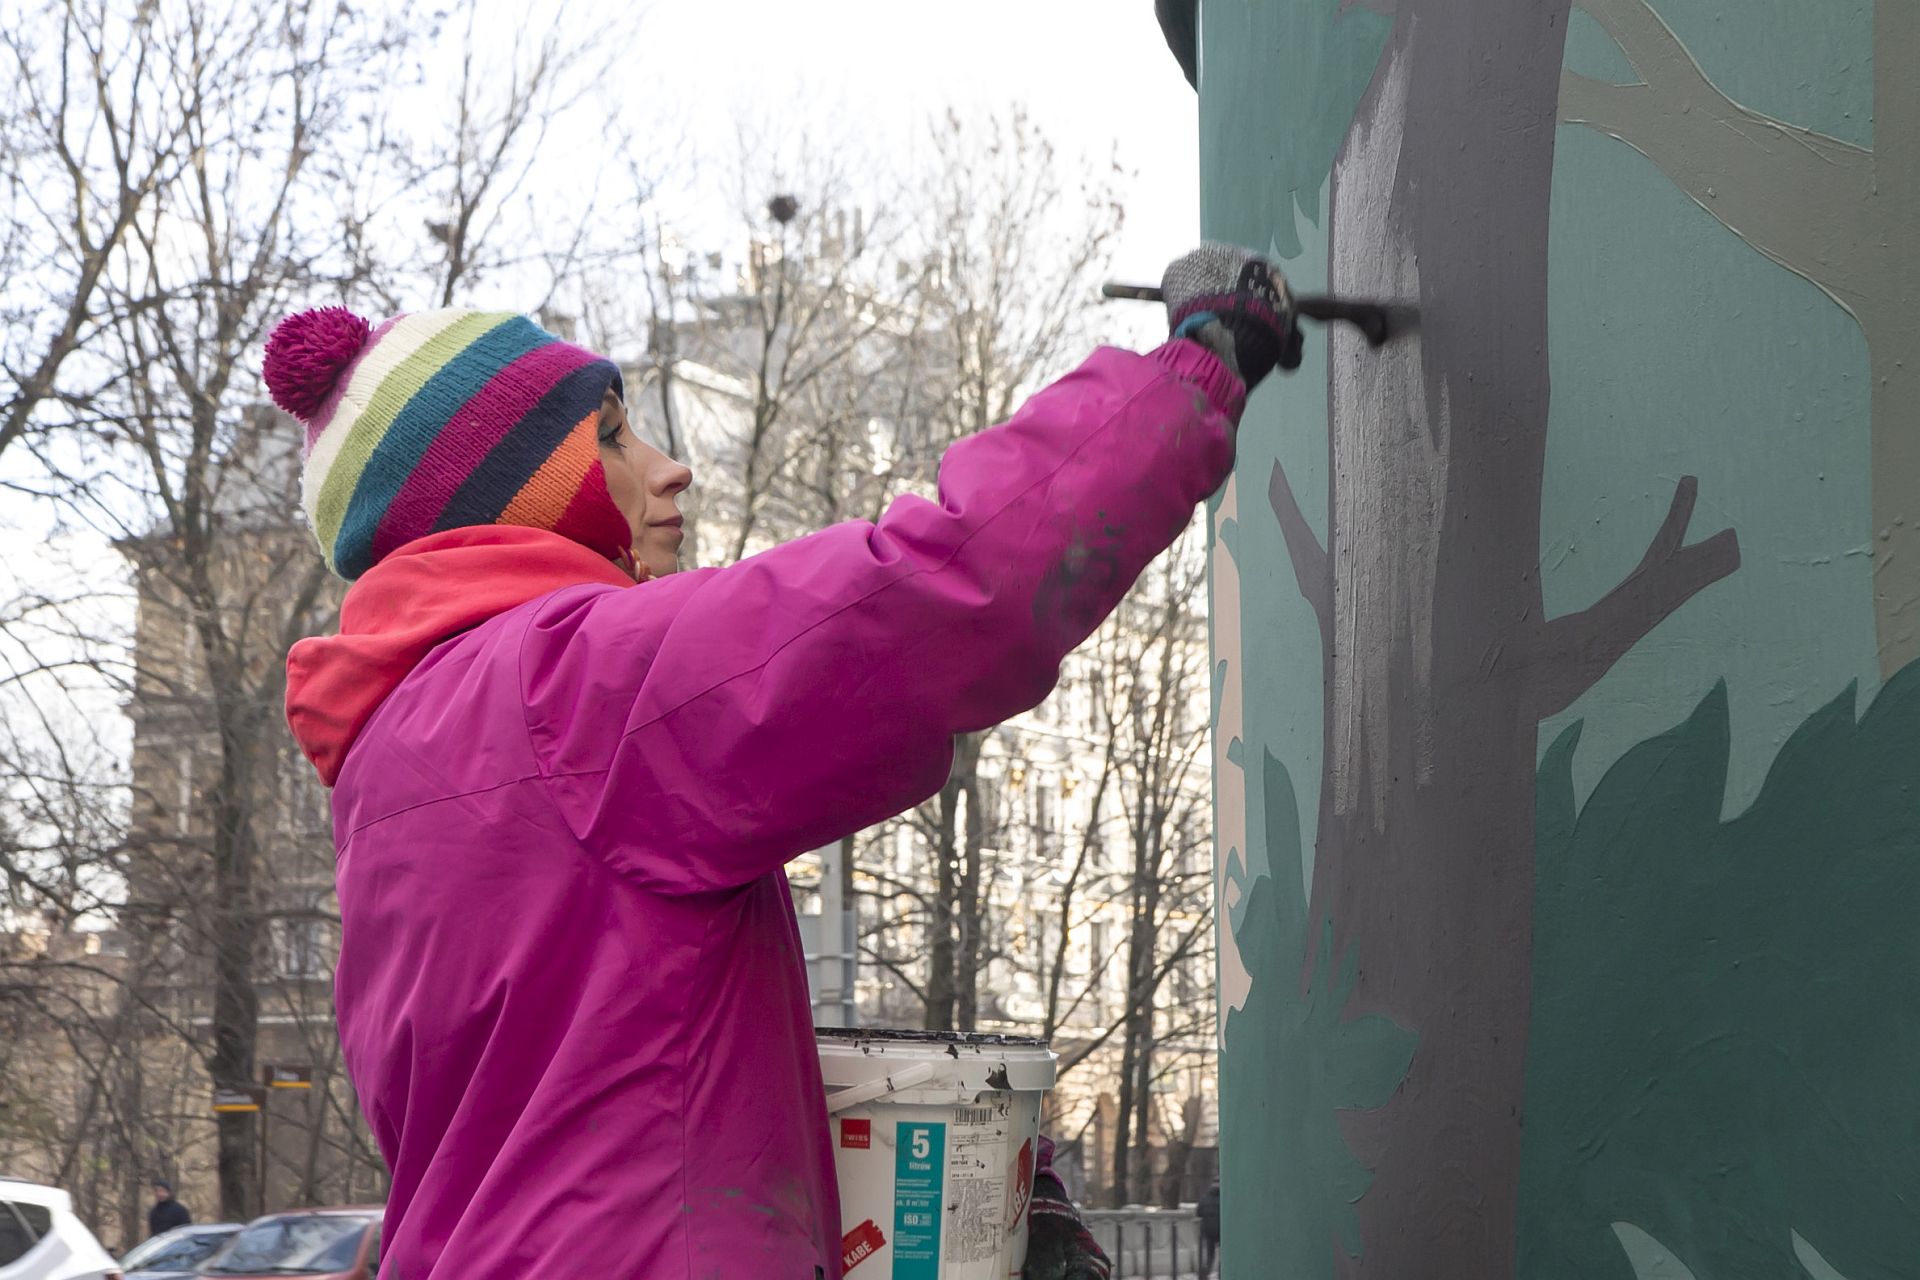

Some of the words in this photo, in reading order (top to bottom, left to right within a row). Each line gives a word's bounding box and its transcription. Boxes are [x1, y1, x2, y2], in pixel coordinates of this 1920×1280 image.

[844, 1134, 868, 1142] WISS
[912, 1129, 930, 1159] 5
[904, 1214, 918, 1225] ISO
[843, 1241, 872, 1267] KABE
